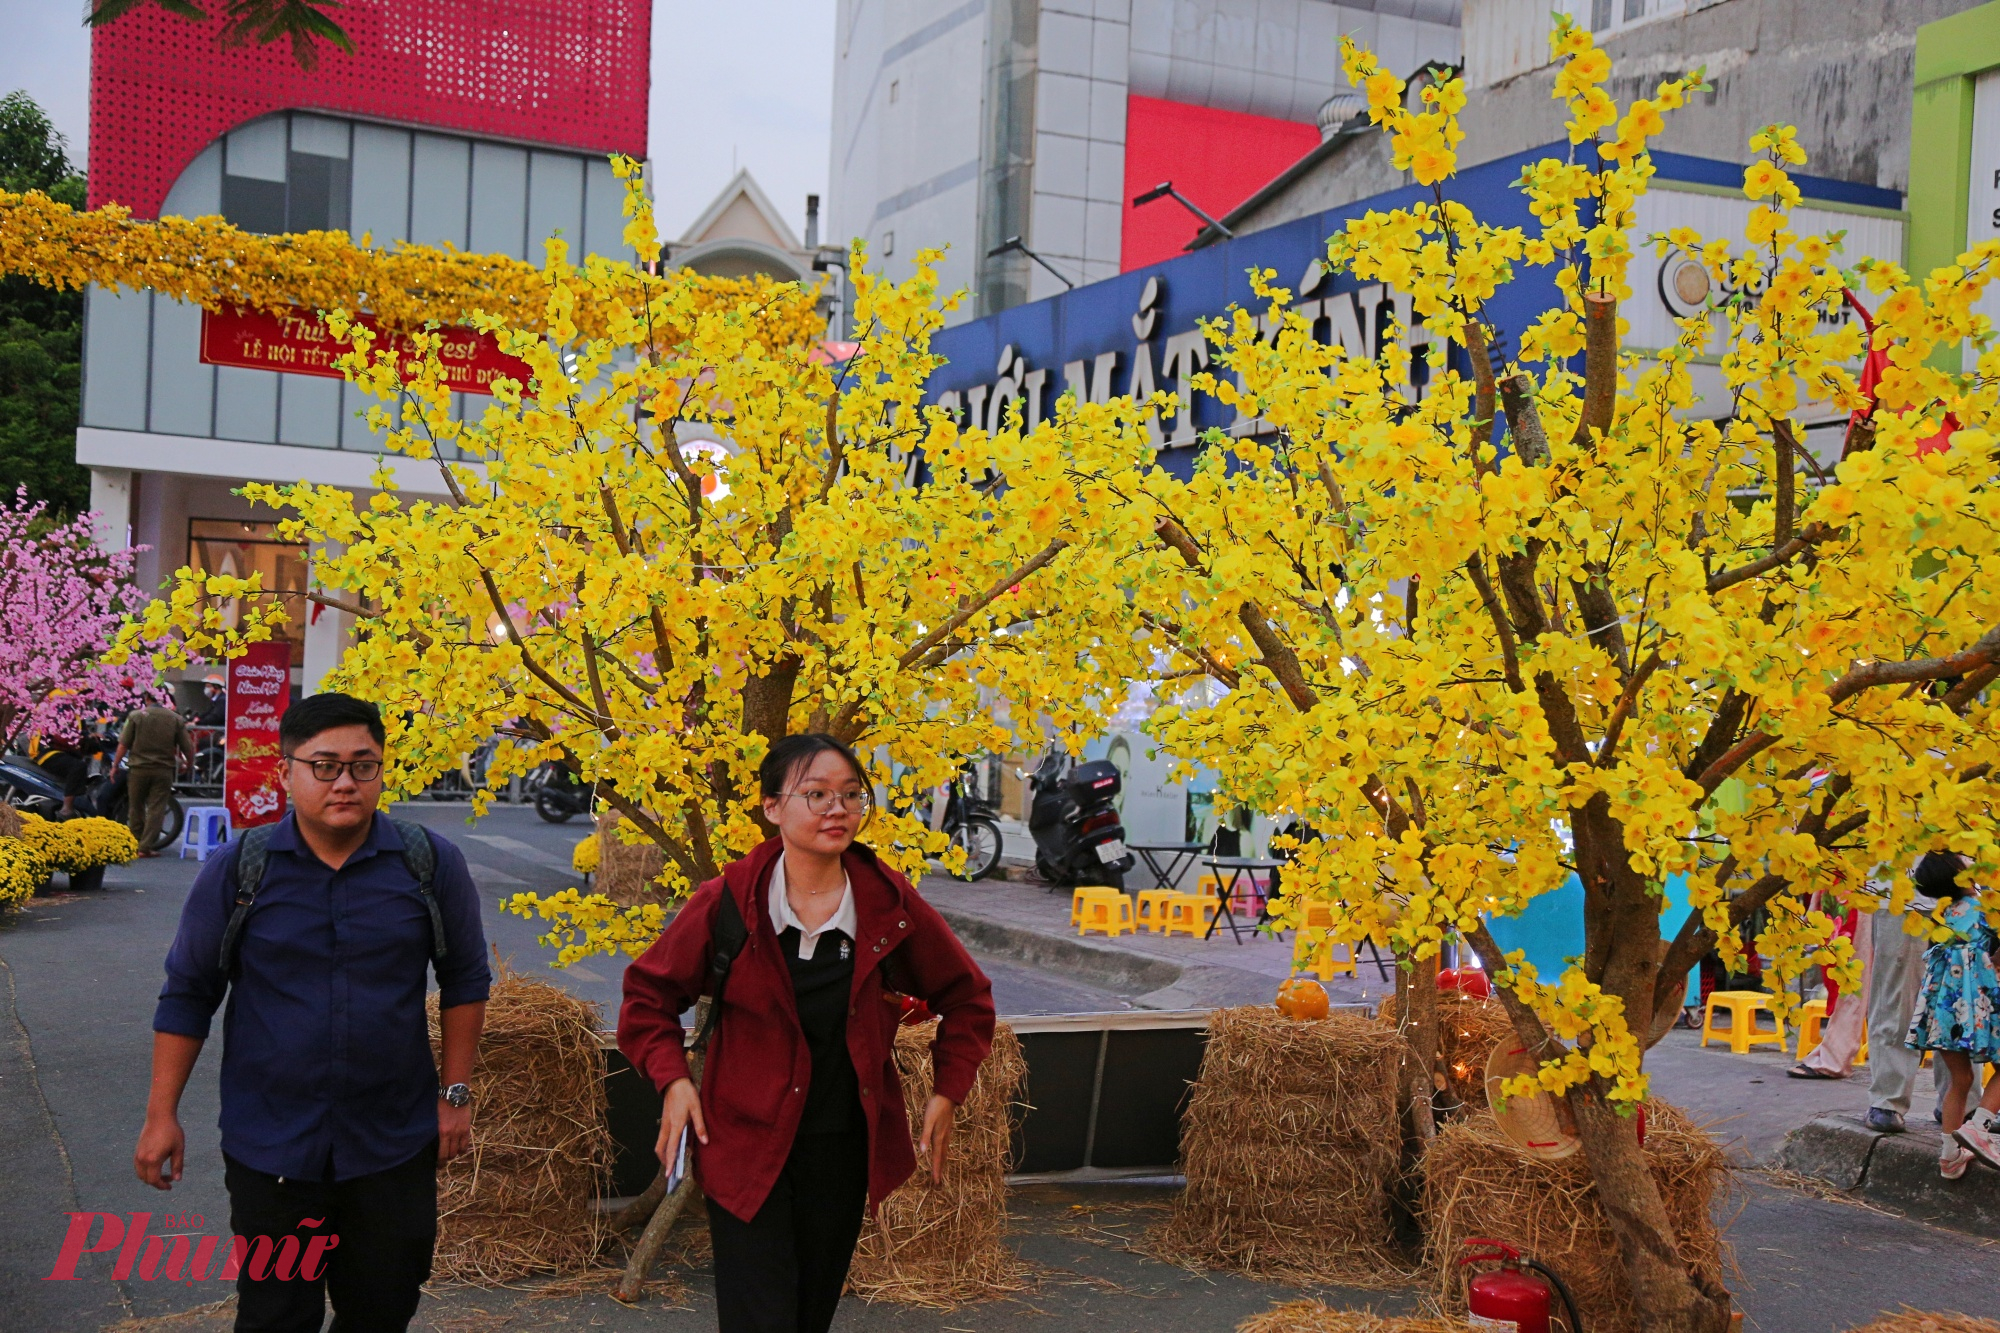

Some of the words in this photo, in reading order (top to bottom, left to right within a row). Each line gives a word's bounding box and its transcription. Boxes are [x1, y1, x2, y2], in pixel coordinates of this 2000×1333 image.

[243, 338, 262, 359] LỄ
[268, 344, 295, 364] HỘI
[301, 346, 330, 366] TẾT
[1064, 276, 1209, 452] MẮT
